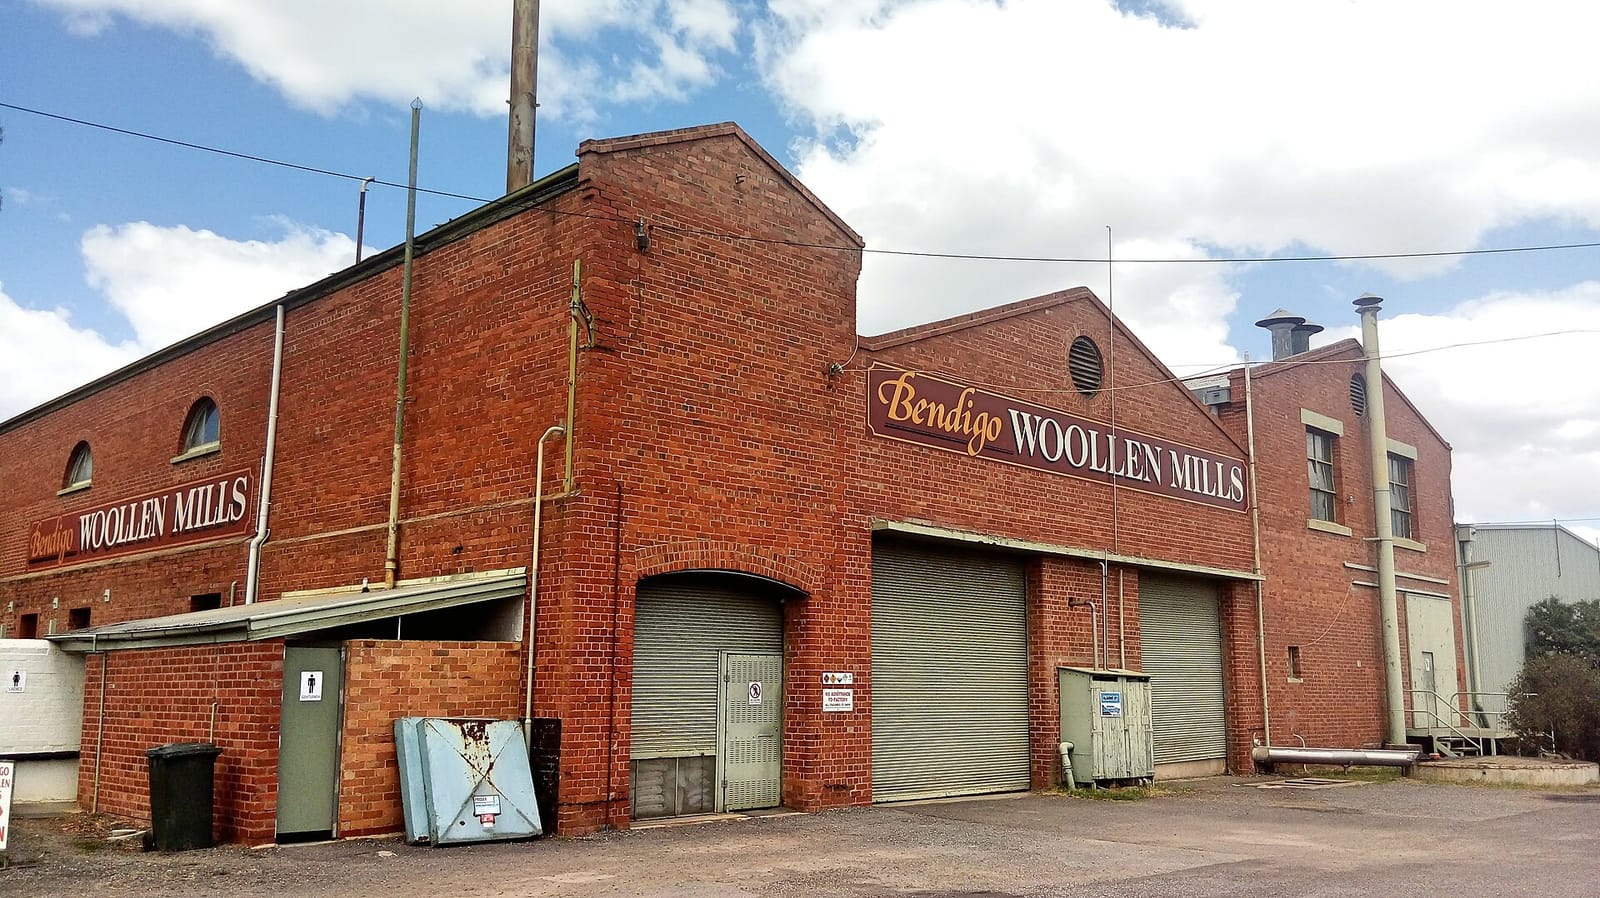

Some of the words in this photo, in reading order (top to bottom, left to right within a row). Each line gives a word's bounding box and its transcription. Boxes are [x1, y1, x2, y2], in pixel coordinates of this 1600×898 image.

[878, 371, 1002, 456] Bendigo
[1007, 408, 1163, 486] WOOLLEN
[1168, 450, 1245, 503] MILLS
[31, 515, 74, 564] Bendigo
[79, 495, 168, 551] WOOLLEN
[172, 476, 248, 533] MILLS
